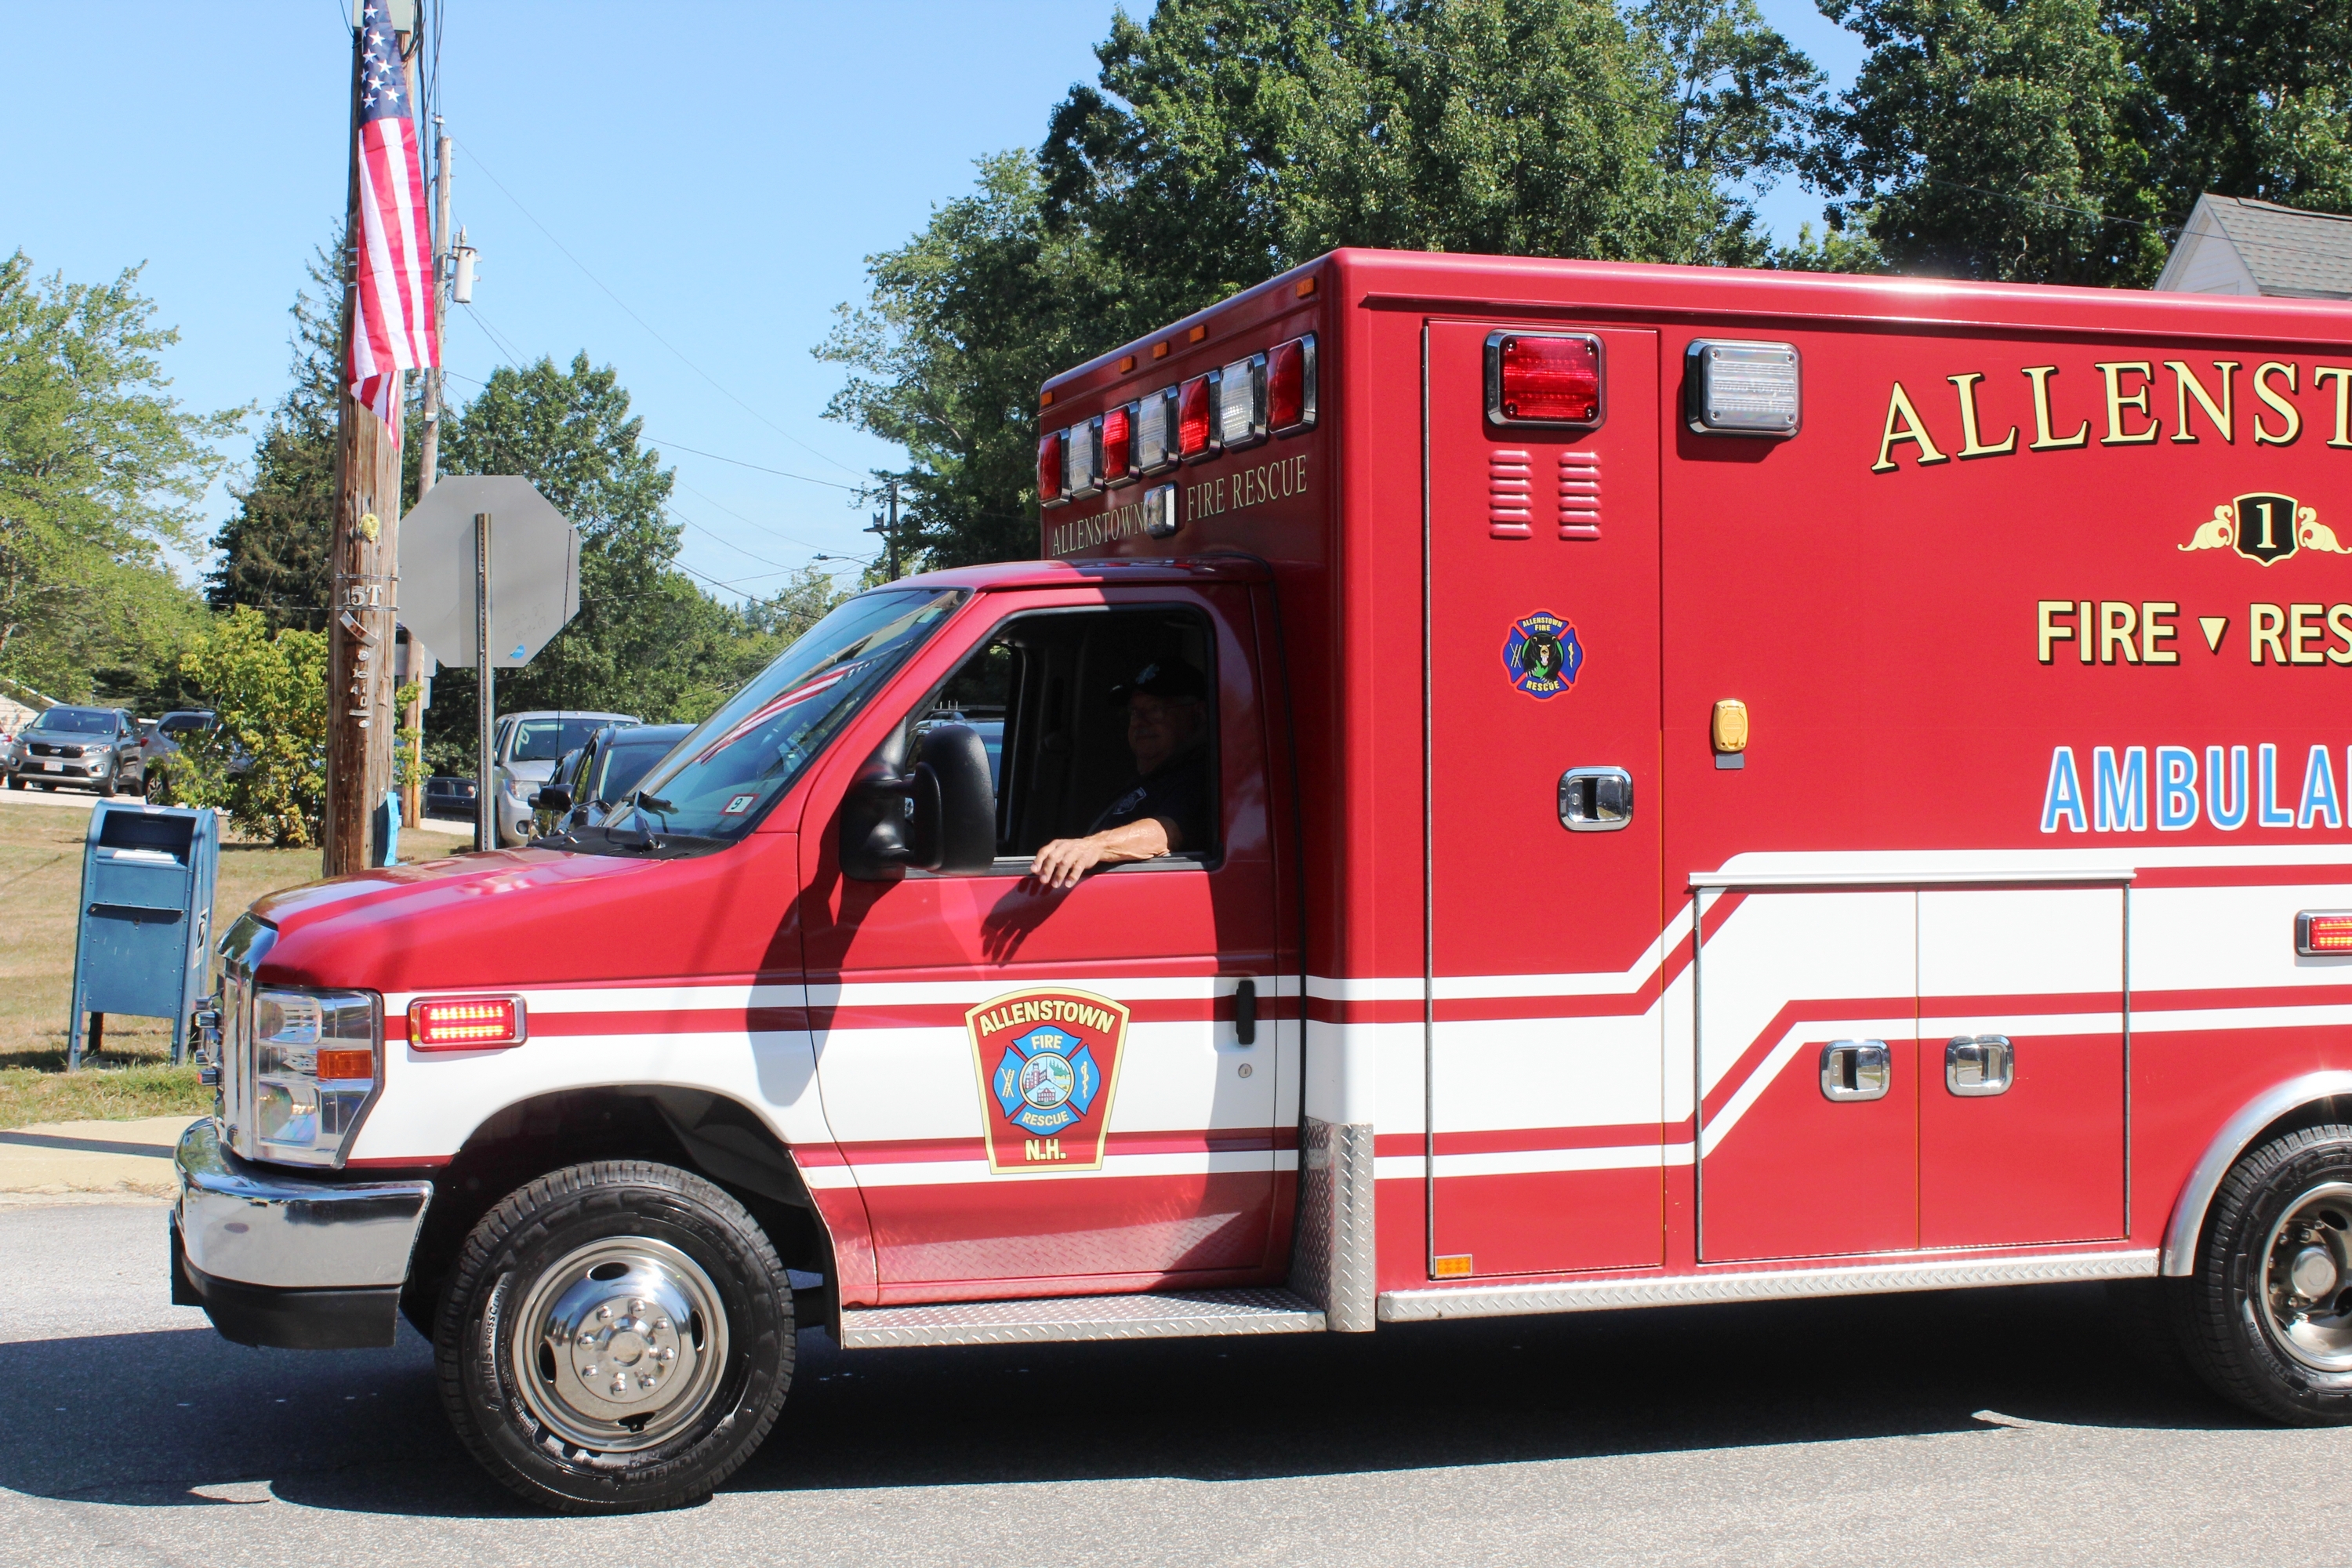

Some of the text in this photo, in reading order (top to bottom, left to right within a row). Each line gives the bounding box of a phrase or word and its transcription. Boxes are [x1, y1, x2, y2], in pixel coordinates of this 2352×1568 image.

[1871, 361, 2352, 474] ALLENST
[1052, 455, 1307, 557] ALLENSTOWN FIRE RESCUE
[2256, 503, 2277, 549] 1
[1522, 617, 1563, 628] ALLENSTOWN
[2038, 600, 2352, 667] FIRE RES
[1526, 680, 1560, 691] RESCUE
[2040, 743, 2352, 833] AMBULA
[731, 797, 743, 810] 9
[979, 1000, 1116, 1037] ALLENSTOWN
[1031, 1034, 1063, 1050] FIRE
[1022, 1110, 1070, 1127] RESCUE
[1025, 1138, 1067, 1161] N.H.
